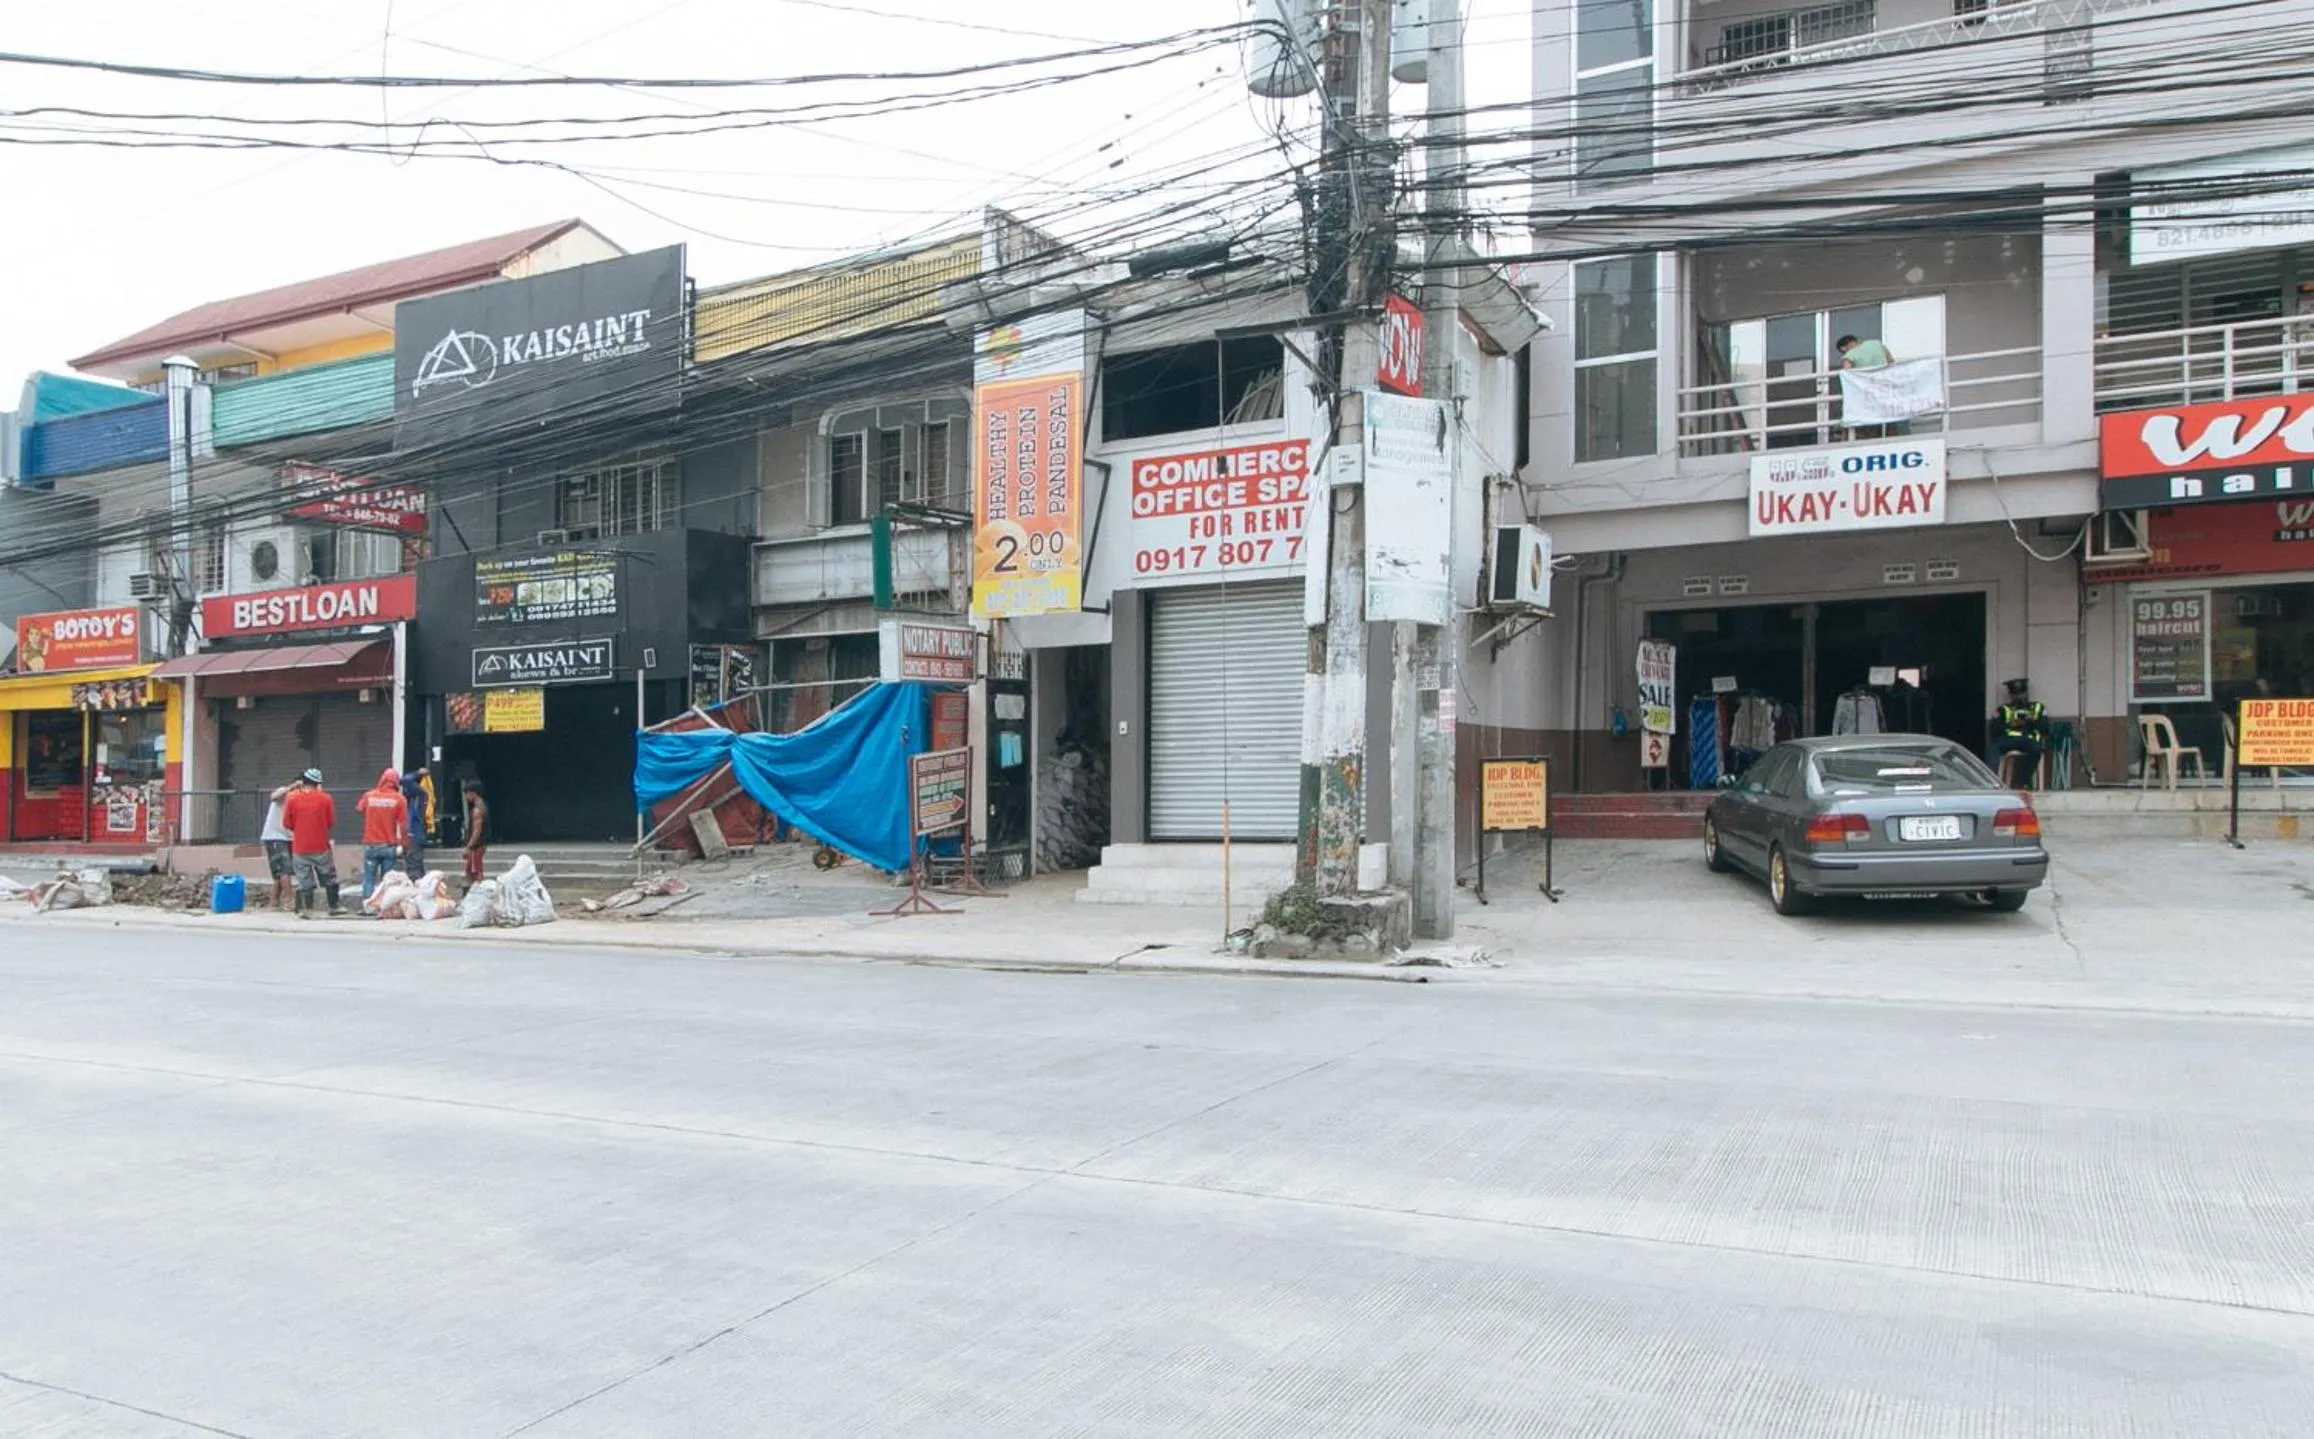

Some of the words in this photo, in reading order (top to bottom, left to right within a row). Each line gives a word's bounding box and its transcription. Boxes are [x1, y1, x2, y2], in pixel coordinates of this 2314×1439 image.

[503, 309, 651, 365] KAISAINT
[988, 412, 1008, 520] HEALTHY
[1018, 407, 1037, 517] PROTEIN
[1047, 386, 1068, 514] PANDESAL
[1138, 446, 1309, 488] COMMERC
[1841, 450, 1931, 474] ORIG.
[1133, 480, 1248, 516] OFFICE
[2169, 466, 2314, 498] hai
[1189, 513, 1233, 540] FOR
[1243, 505, 1305, 535] RENT
[993, 530, 1065, 572] 2.00
[1135, 544, 1208, 574] 0917
[1217, 539, 1274, 567] 807
[1285, 535, 1308, 560] 7
[233, 587, 378, 630] BESTLOAN
[2138, 600, 2200, 620] 99.95
[53, 613, 136, 641] BOTOY'S
[903, 626, 940, 654] NOTARY
[2136, 620, 2201, 636] haircut
[508, 646, 606, 670] KAISAINT
[1639, 683, 1672, 709] SALE
[1915, 825, 1954, 838] CIVIC
